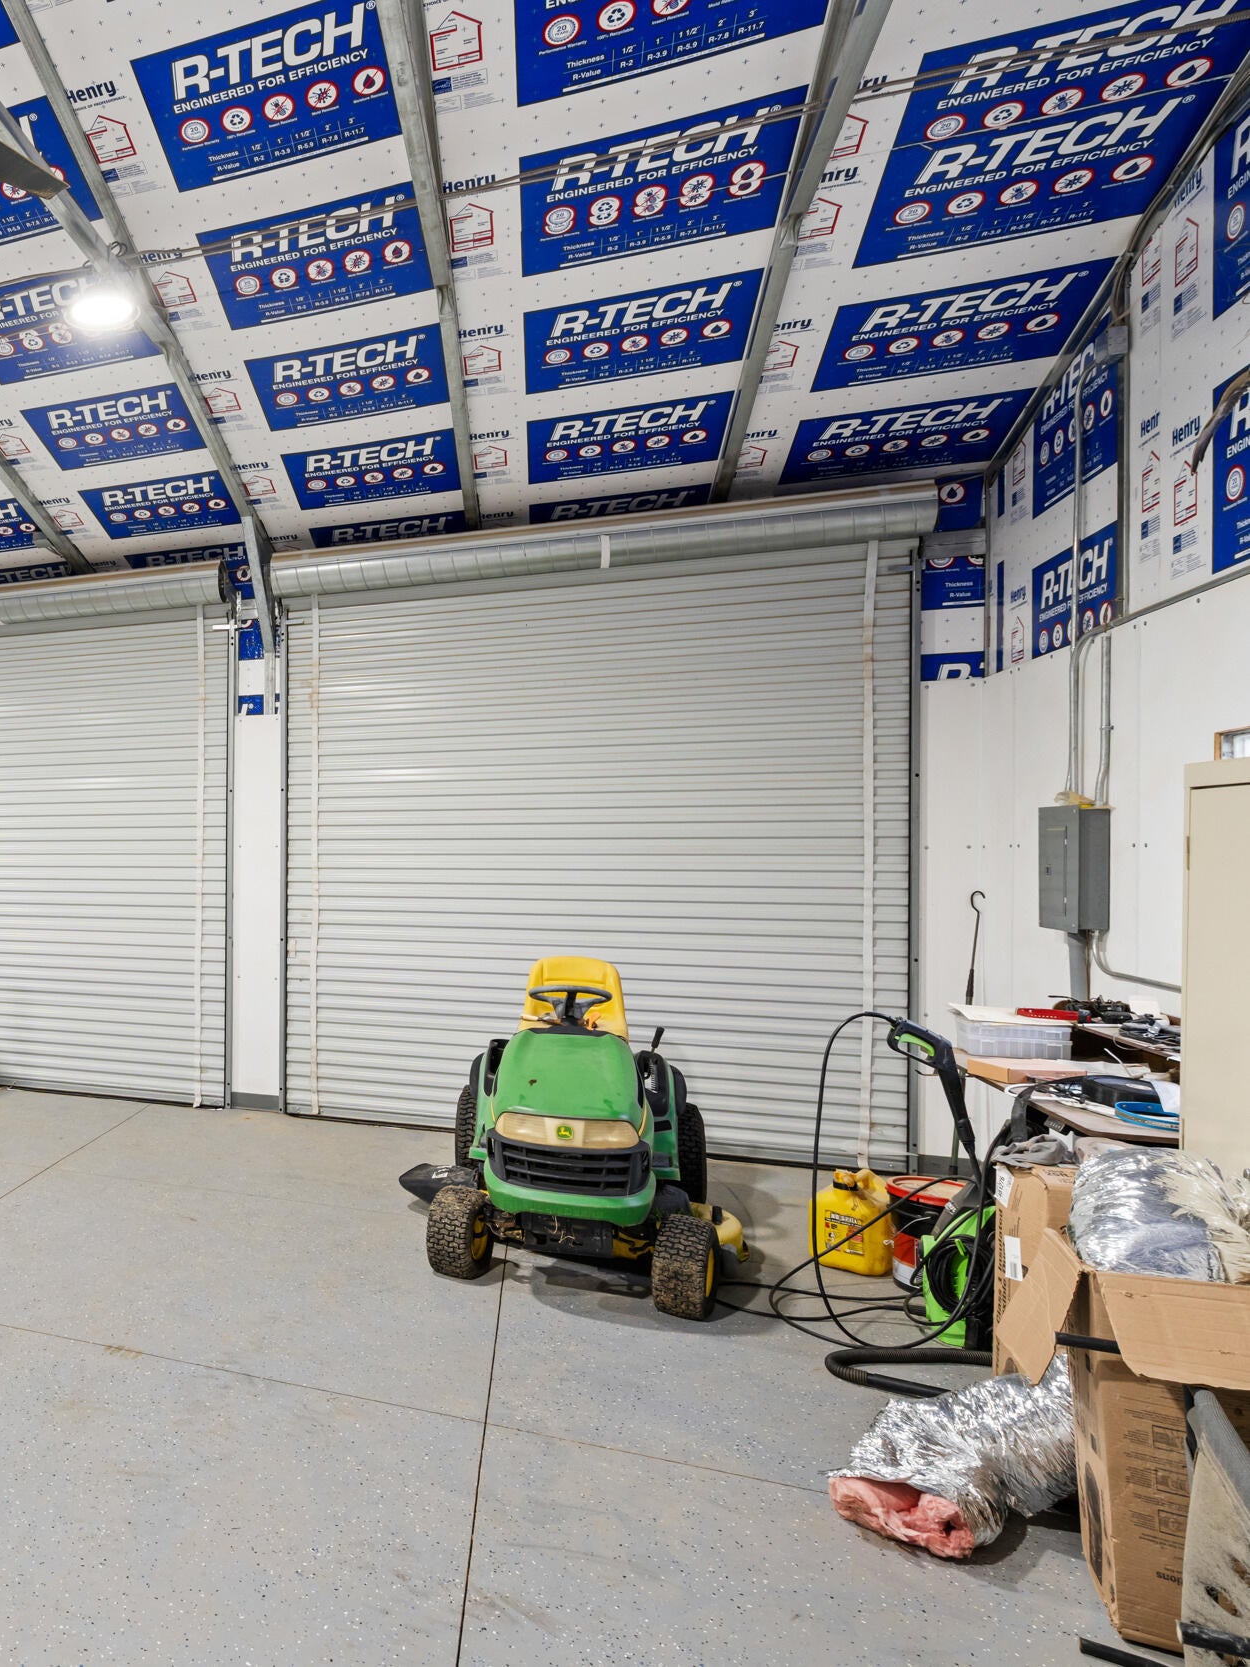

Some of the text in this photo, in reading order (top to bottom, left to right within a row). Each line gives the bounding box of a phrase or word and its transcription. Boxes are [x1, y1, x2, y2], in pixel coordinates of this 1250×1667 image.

[555, 23, 568, 34] 20
[566, 51, 606, 71] Thickness
[572, 21, 766, 82] R-Value R-2 R-3.9 R-5.9 R-7.8 R-11.7
[172, 47, 370, 115] ENGINEERED FOR EFFICIENCY
[937, 37, 1215, 110] ENGINEERED FOR EFFICIENCY
[66, 80, 117, 104] Henry
[207, 148, 239, 163] Thickness
[216, 126, 365, 172] R-Value R-2 R-3.9 R-5.9 R-7.8 R-11.7
[545, 146, 758, 205] ENGINEERED FOR EFFICIENCY
[902, 138, 1154, 199] ENGINEERED FOR EFFICIENCY
[229, 227, 399, 274] ENGINEERED FOR EFFICIENCY
[459, 323, 504, 339] Henry
[545, 308, 724, 346] ENGINEERED FOR EFFICIENCY
[850, 300, 1059, 342] ENGINEERED FOR EFFICIENCY
[192, 368, 231, 381] Henry
[271, 358, 420, 391] ENGINEERED FOR EFFICIENCY
[470, 429, 510, 441] Henry
[546, 420, 701, 447] ENGINEERED FOR EFFICIENCY
[1172, 415, 1201, 447] Henry
[235, 460, 269, 471] Henry
[304, 466, 359, 478] ENGINEERED
[381, 454, 435, 467] EFFICIENCY
